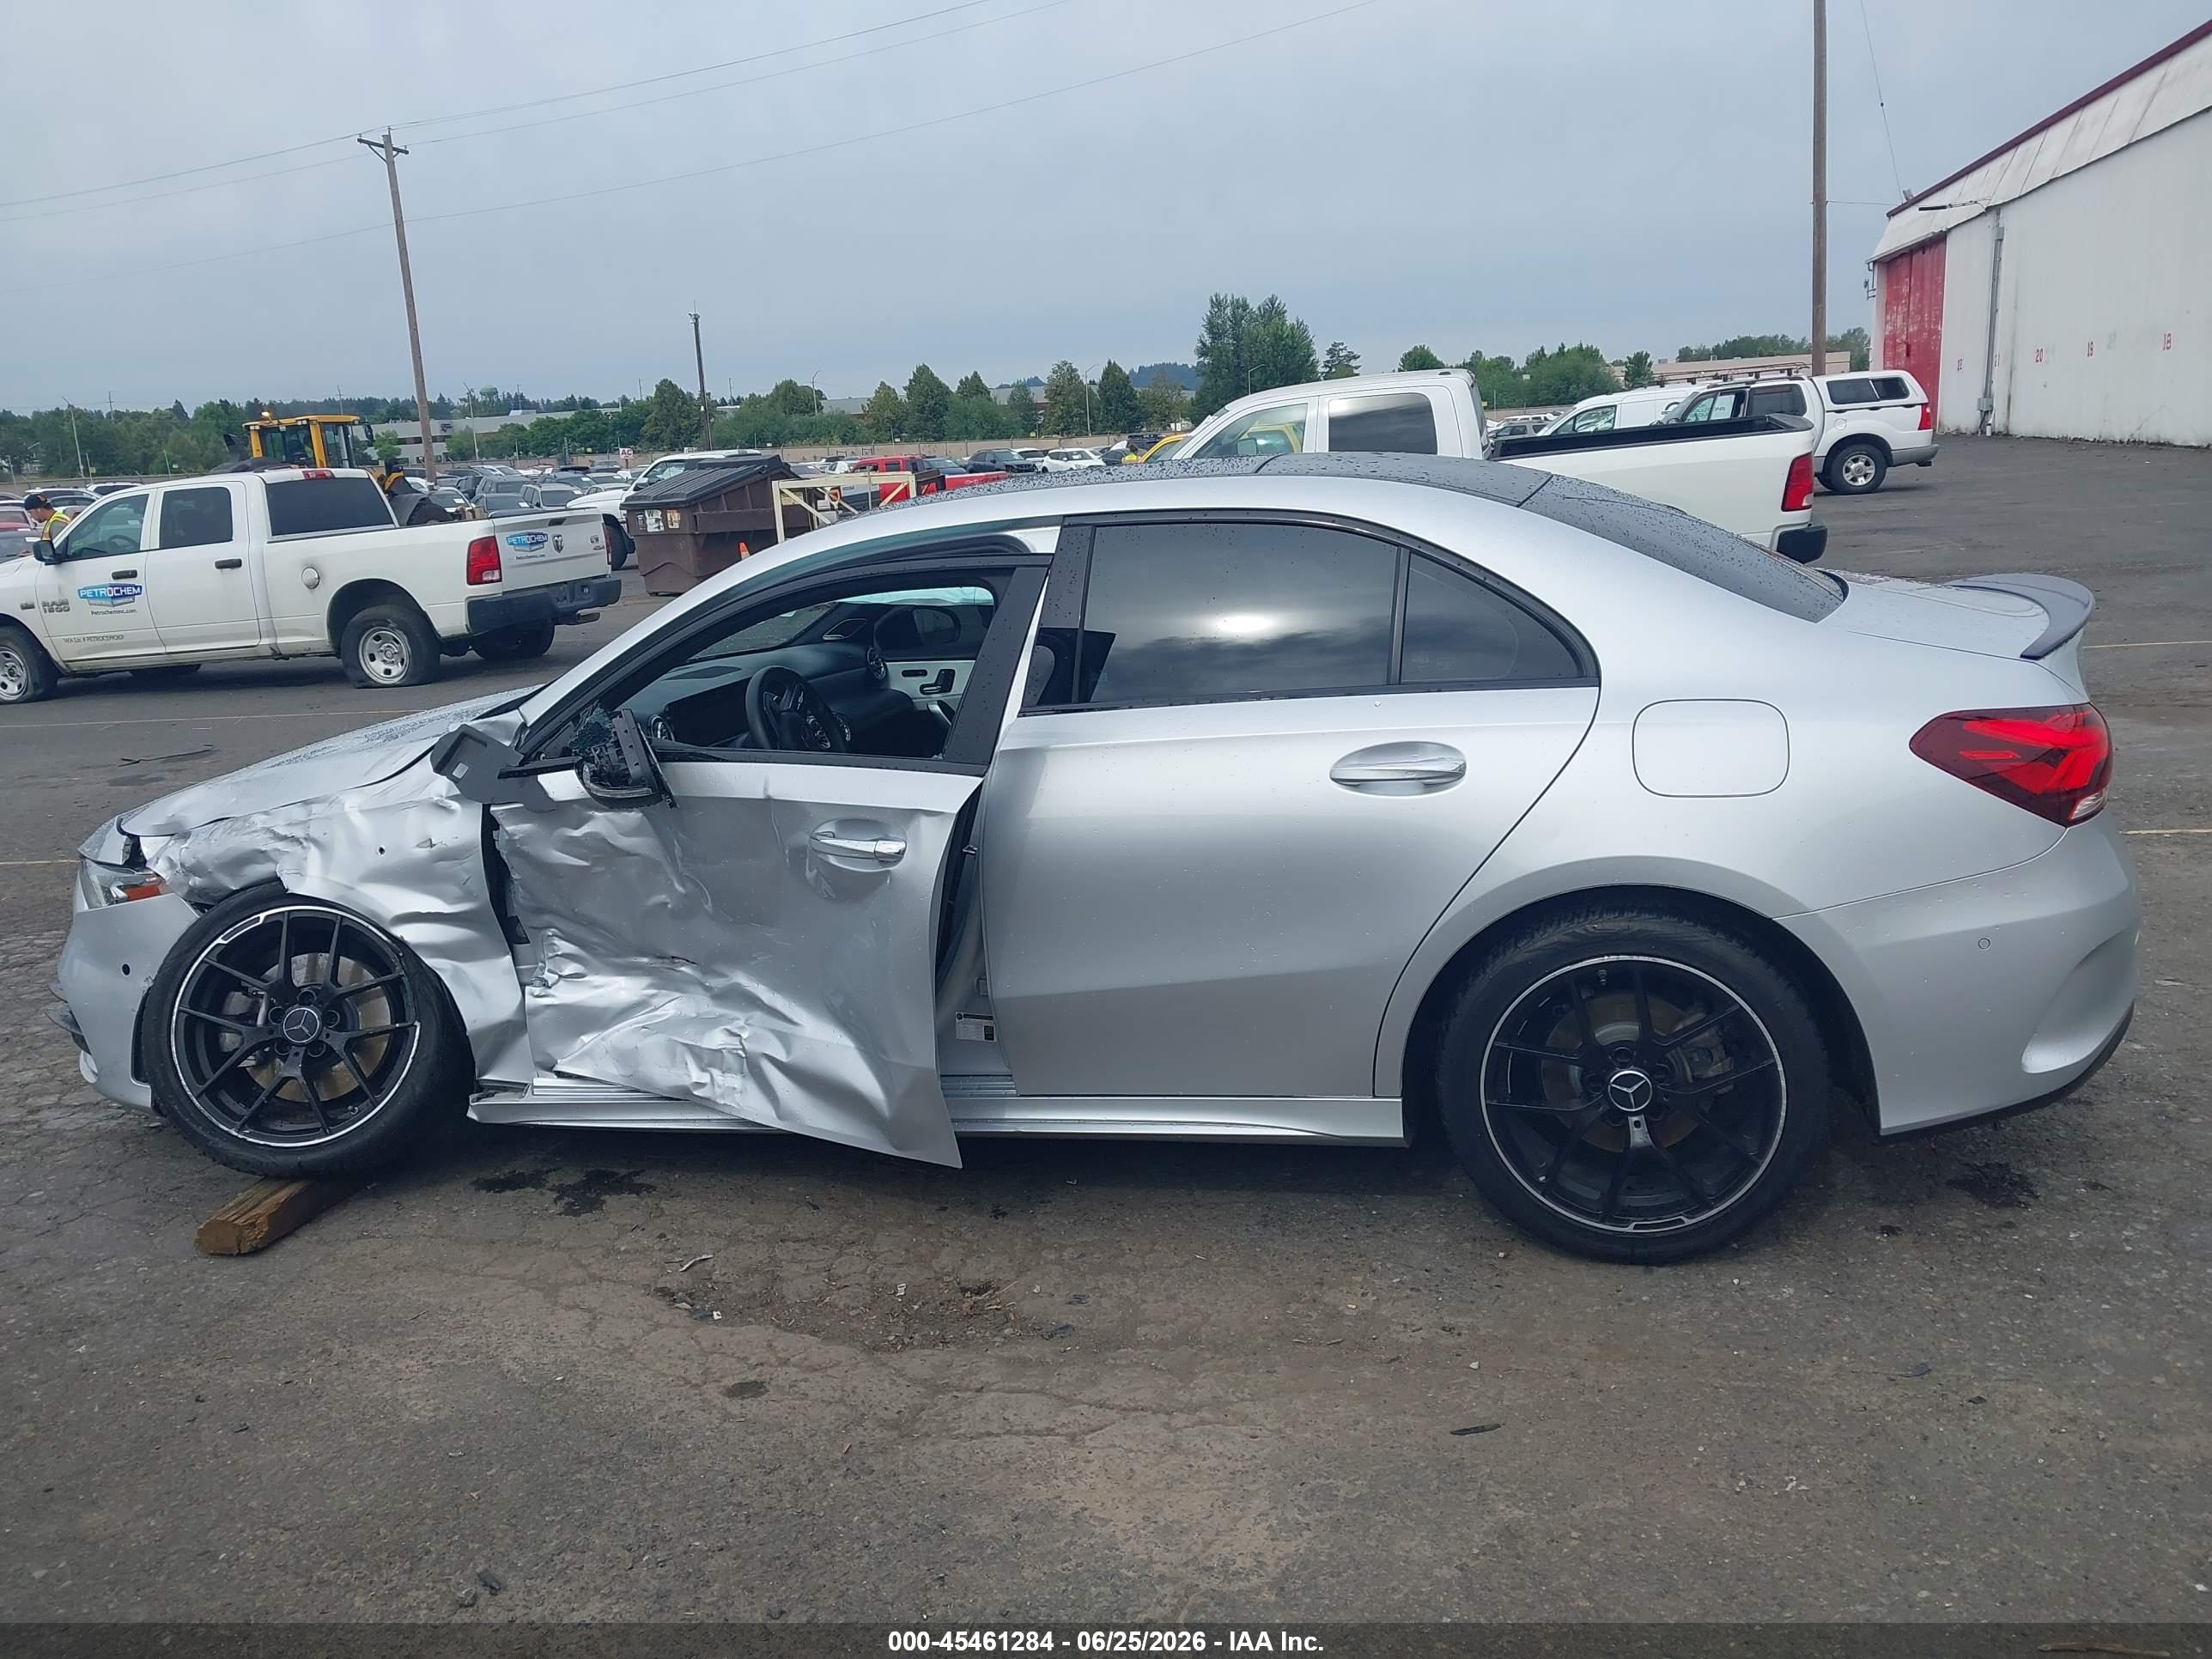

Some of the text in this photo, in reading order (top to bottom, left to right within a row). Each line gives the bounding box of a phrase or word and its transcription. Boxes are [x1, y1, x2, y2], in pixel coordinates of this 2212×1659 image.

[2162, 332, 2172, 350] 18
[2035, 348, 2044, 362] 20
[2087, 341, 2094, 357] 19
[507, 535, 548, 544] PETROCHEM
[80, 586, 141, 599] PETROCHEM
[43, 605, 70, 613] 1500
